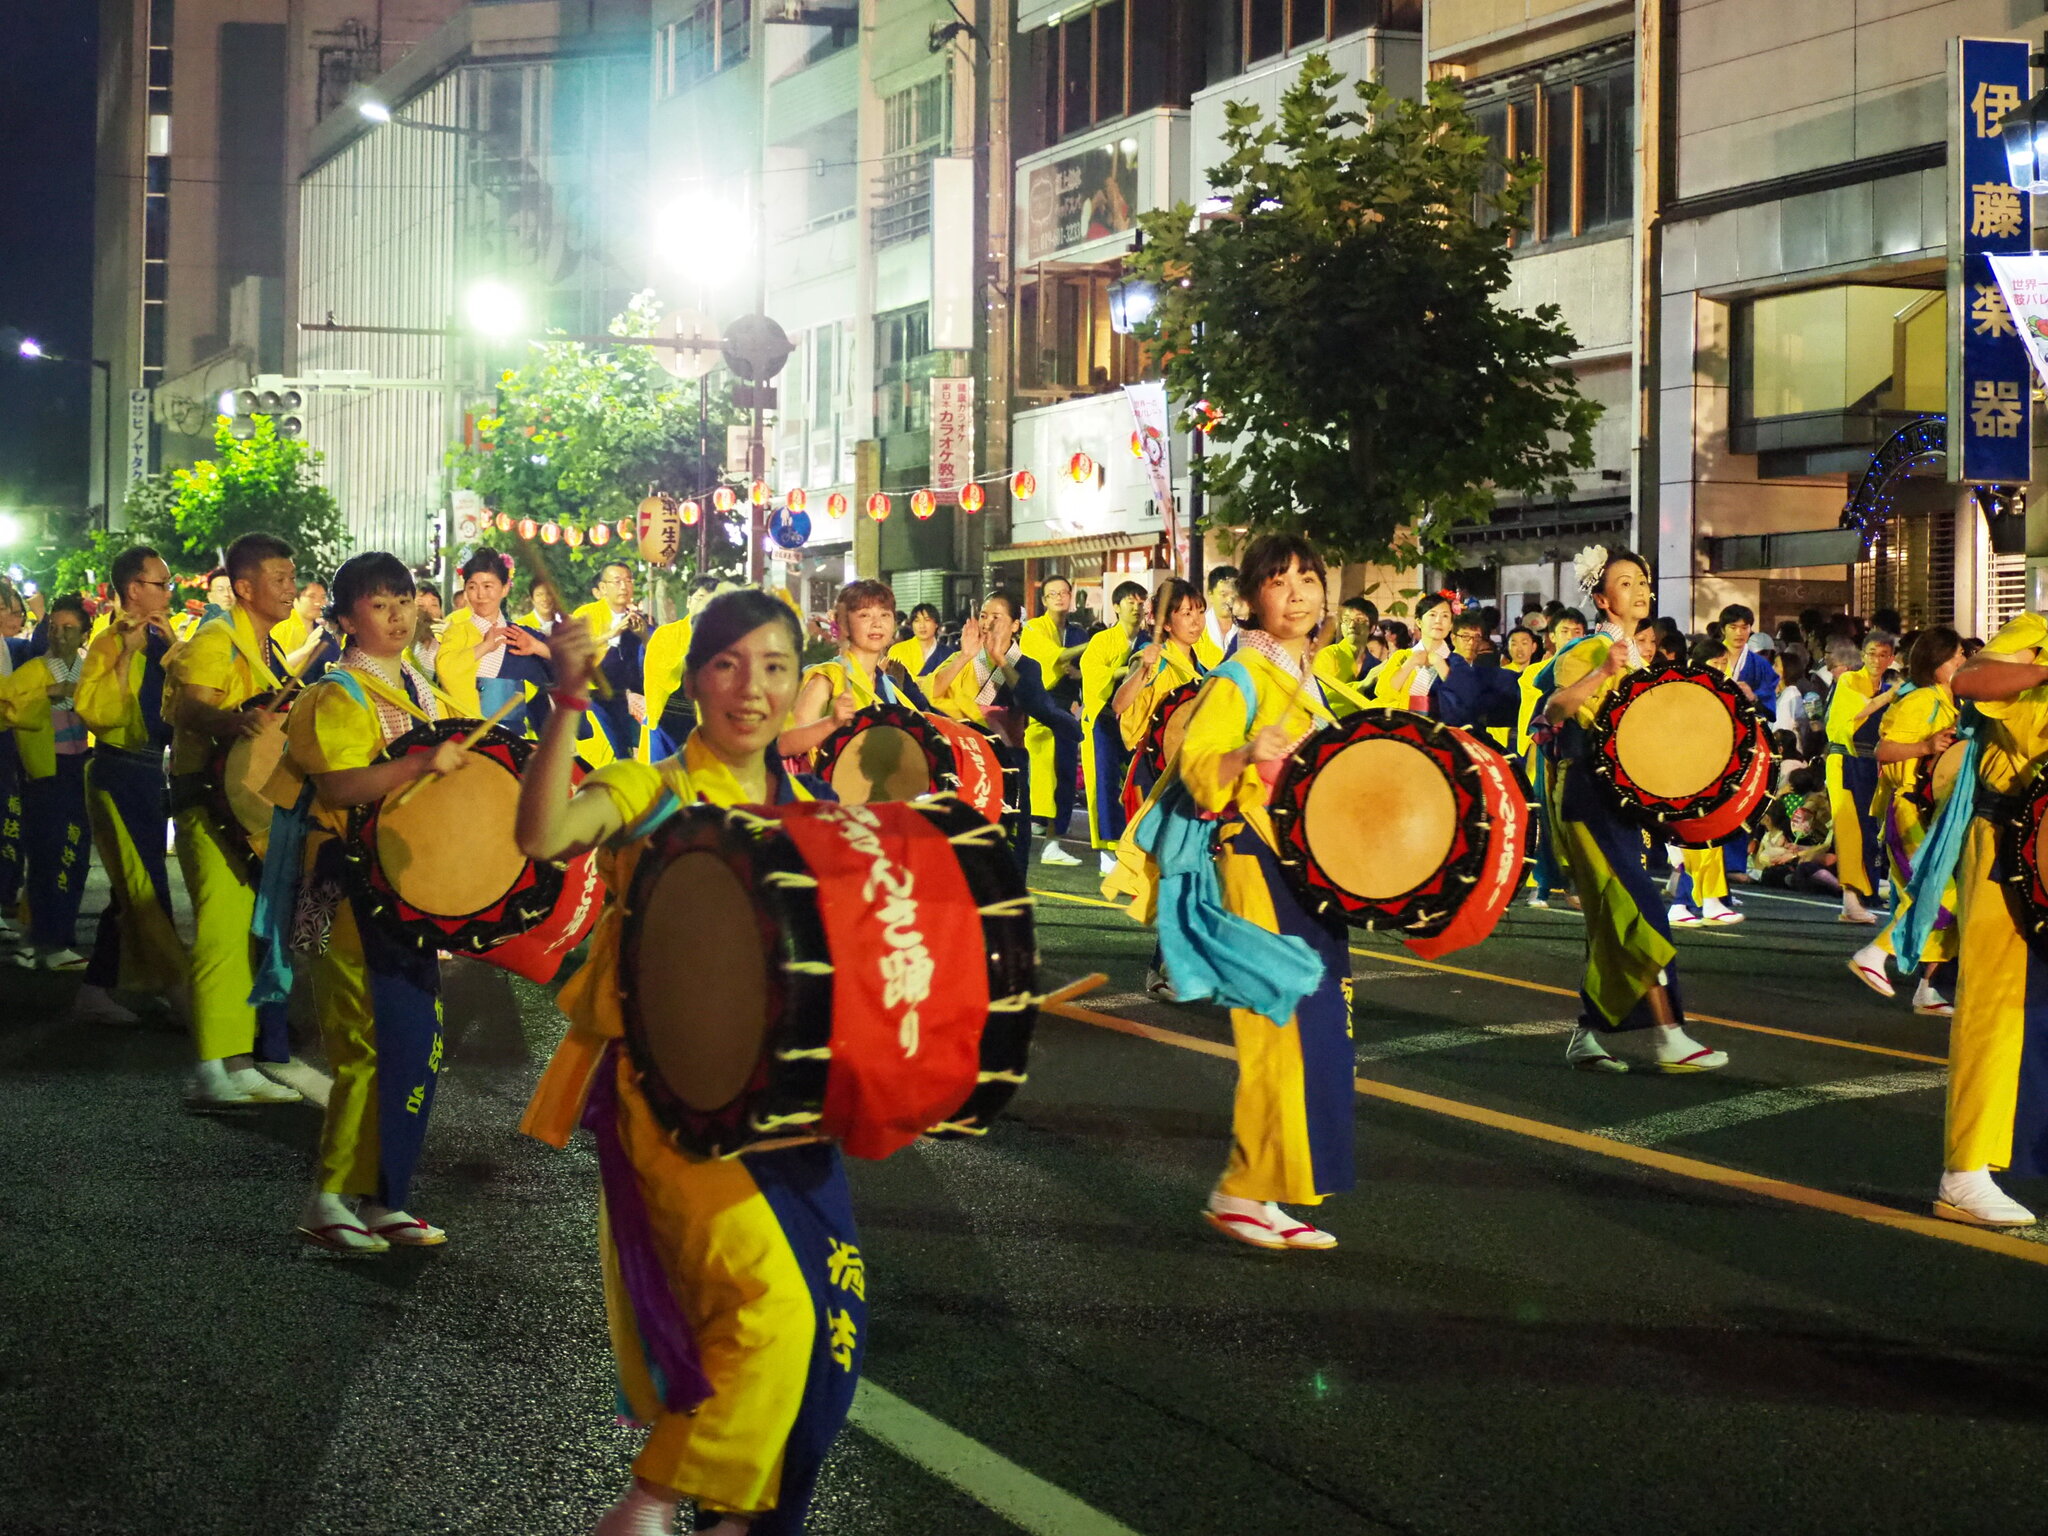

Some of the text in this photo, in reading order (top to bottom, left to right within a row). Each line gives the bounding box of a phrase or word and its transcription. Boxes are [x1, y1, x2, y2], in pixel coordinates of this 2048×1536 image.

[1971, 82, 2023, 438] 伊藤楽器
[957, 383, 967, 442] 健康カラオケ
[660, 497, 678, 560] 第一生命
